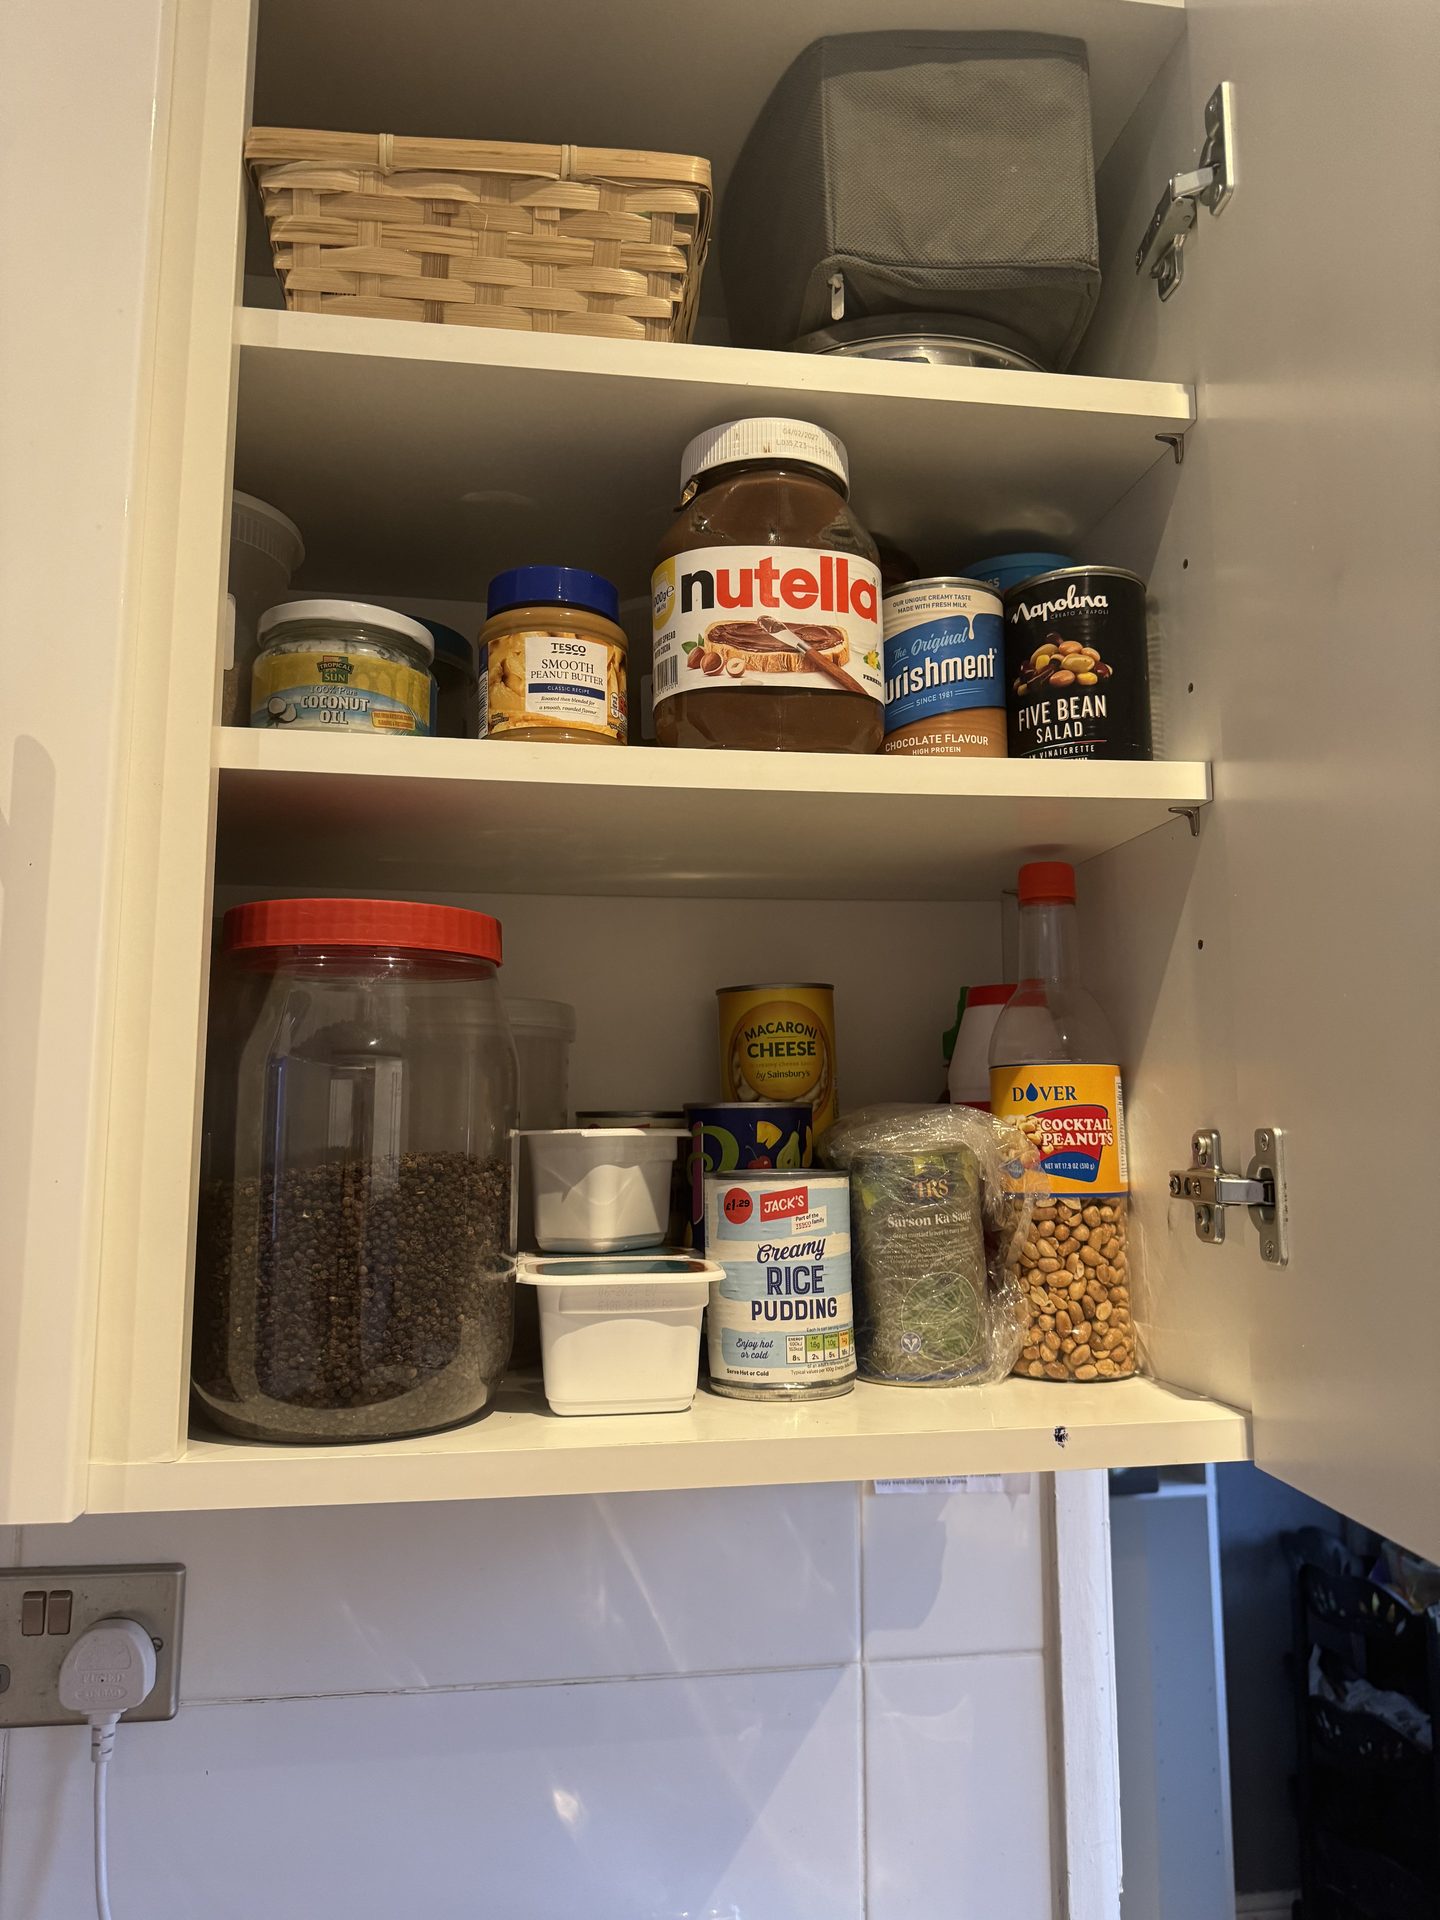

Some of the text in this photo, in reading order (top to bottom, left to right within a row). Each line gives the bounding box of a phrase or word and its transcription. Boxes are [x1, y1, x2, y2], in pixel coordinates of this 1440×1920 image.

[681, 555, 878, 624] nutella
[892, 600, 905, 608] OUR
[904, 595, 927, 605] UNIQUE
[898, 606, 914, 614] MADE
[915, 603, 931, 611] WITH
[1011, 584, 1109, 624] Napolina
[1050, 611, 1076, 620] CREATO
[551, 643, 587, 655] TESCO
[894, 627, 969, 660] The Original
[319, 662, 352, 672] TROPICAL
[541, 659, 595, 674] SMOOTH
[324, 672, 346, 683] SUN
[531, 670, 604, 686] PEANUT BUTTER
[885, 648, 996, 705] urishment
[310, 686, 359, 697] 100% Pure
[915, 691, 954, 707] SINCE 1981
[300, 695, 370, 712] COCONUT
[563, 705, 581, 713] rounded
[319, 711, 349, 725] OIL
[1018, 695, 1107, 732] FIVE BEAN
[1036, 721, 1084, 744] SALAD
[885, 733, 989, 752] CHOCOLATE FLAVOUR
[912, 746, 961, 756] HIGH PROTEIN
[1040, 744, 1095, 759] VINAIGRETTE
[744, 1021, 818, 1042] MACARONI
[747, 1041, 816, 1058] CHEESE
[756, 1069, 810, 1081] by Sainsbury's
[1041, 1117, 1113, 1132] COCKTAIL
[1042, 1131, 1114, 1146] PEANUTS
[1044, 1162, 1054, 1170] NET
[1054, 1162, 1062, 1170] WT
[911, 1178, 949, 1201] TRS
[726, 1198, 750, 1211] £1.29
[764, 1195, 805, 1214] JACK'S
[795, 1217, 825, 1229] TESCO family
[887, 1209, 972, 1228] Sarson Ka Saag
[757, 1238, 827, 1263] Creamy
[766, 1265, 825, 1295] RICE
[751, 1296, 837, 1321] PUDDING
[736, 1338, 774, 1350] Enjoy hot
[740, 1351, 769, 1359] or cold
